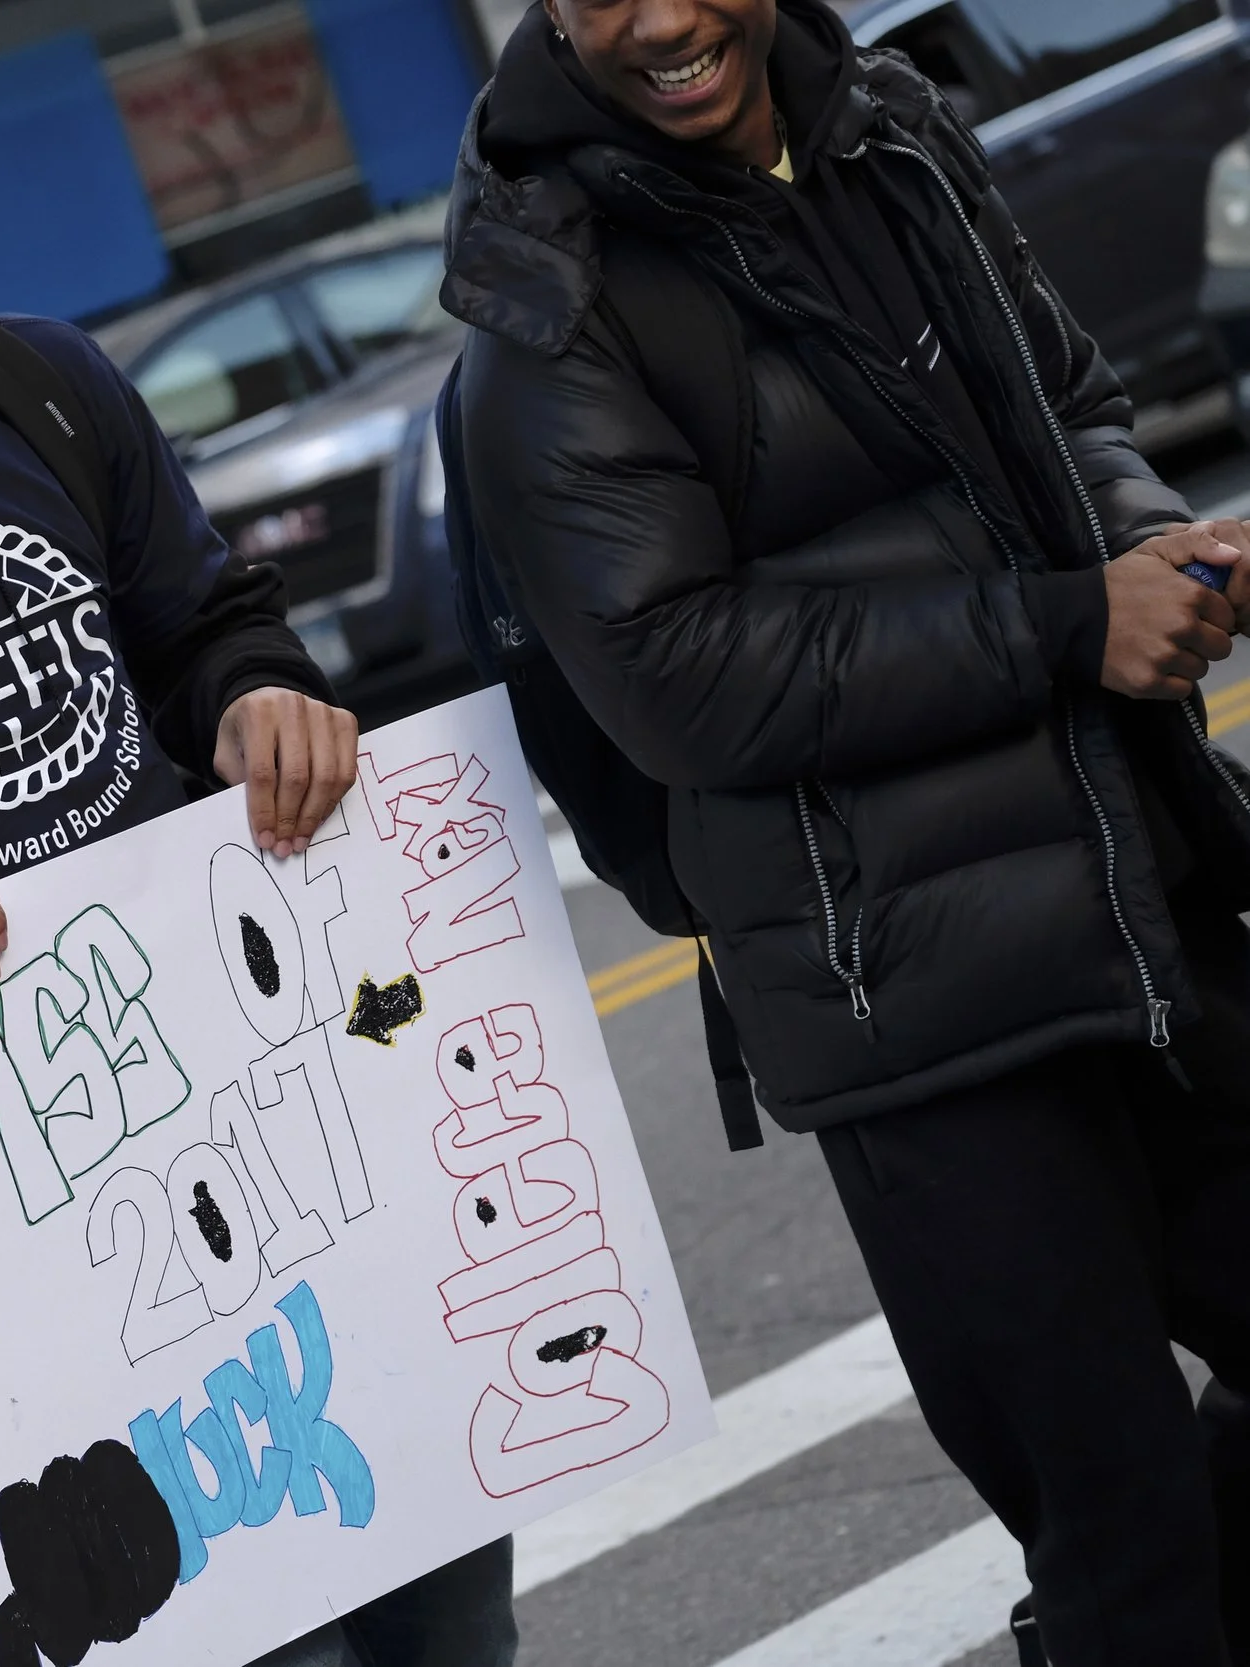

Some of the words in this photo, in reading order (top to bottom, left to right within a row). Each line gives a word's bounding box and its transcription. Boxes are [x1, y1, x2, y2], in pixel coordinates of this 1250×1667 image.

[70, 766, 132, 839] Bound
[116, 684, 141, 771] School
[86, 1022, 375, 1368] 2017
[128, 1279, 376, 1586] LUCK
